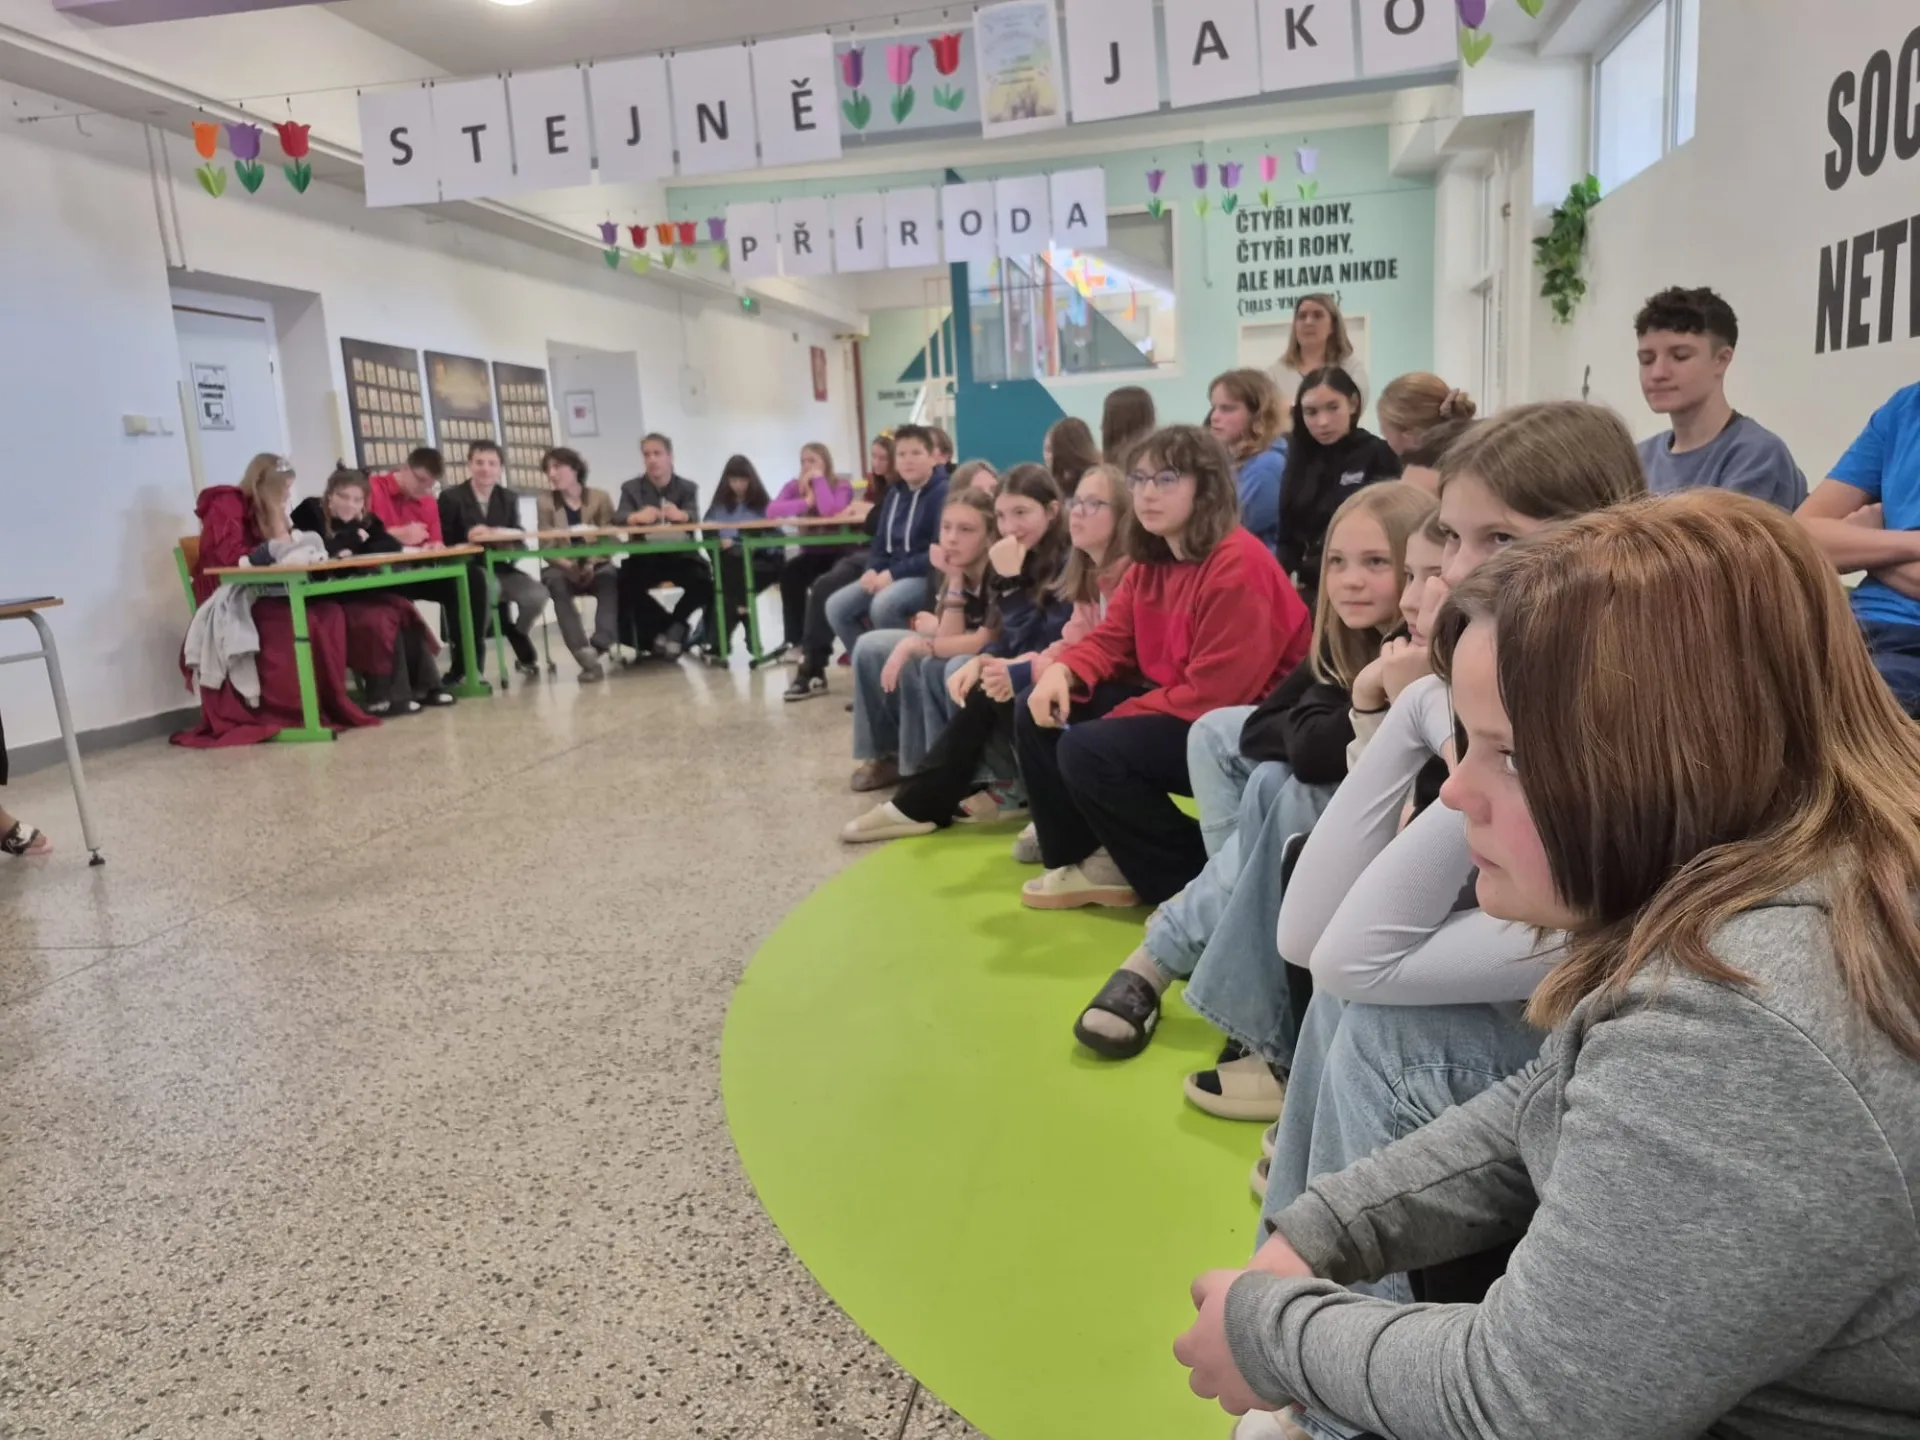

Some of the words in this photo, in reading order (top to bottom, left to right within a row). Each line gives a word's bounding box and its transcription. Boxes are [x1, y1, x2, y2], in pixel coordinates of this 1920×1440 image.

[389, 77, 817, 166] STEJNĚ
[1103, 0, 1426, 85] JAKO
[741, 203, 1088, 261] PŘÍRODA
[1236, 205, 1293, 234] ČTYŘI
[1236, 235, 1293, 264] ČTYŘI
[1236, 270, 1269, 293] ALE
[1273, 264, 1334, 289] HLAVA
[1339, 258, 1398, 283] NIKDE
